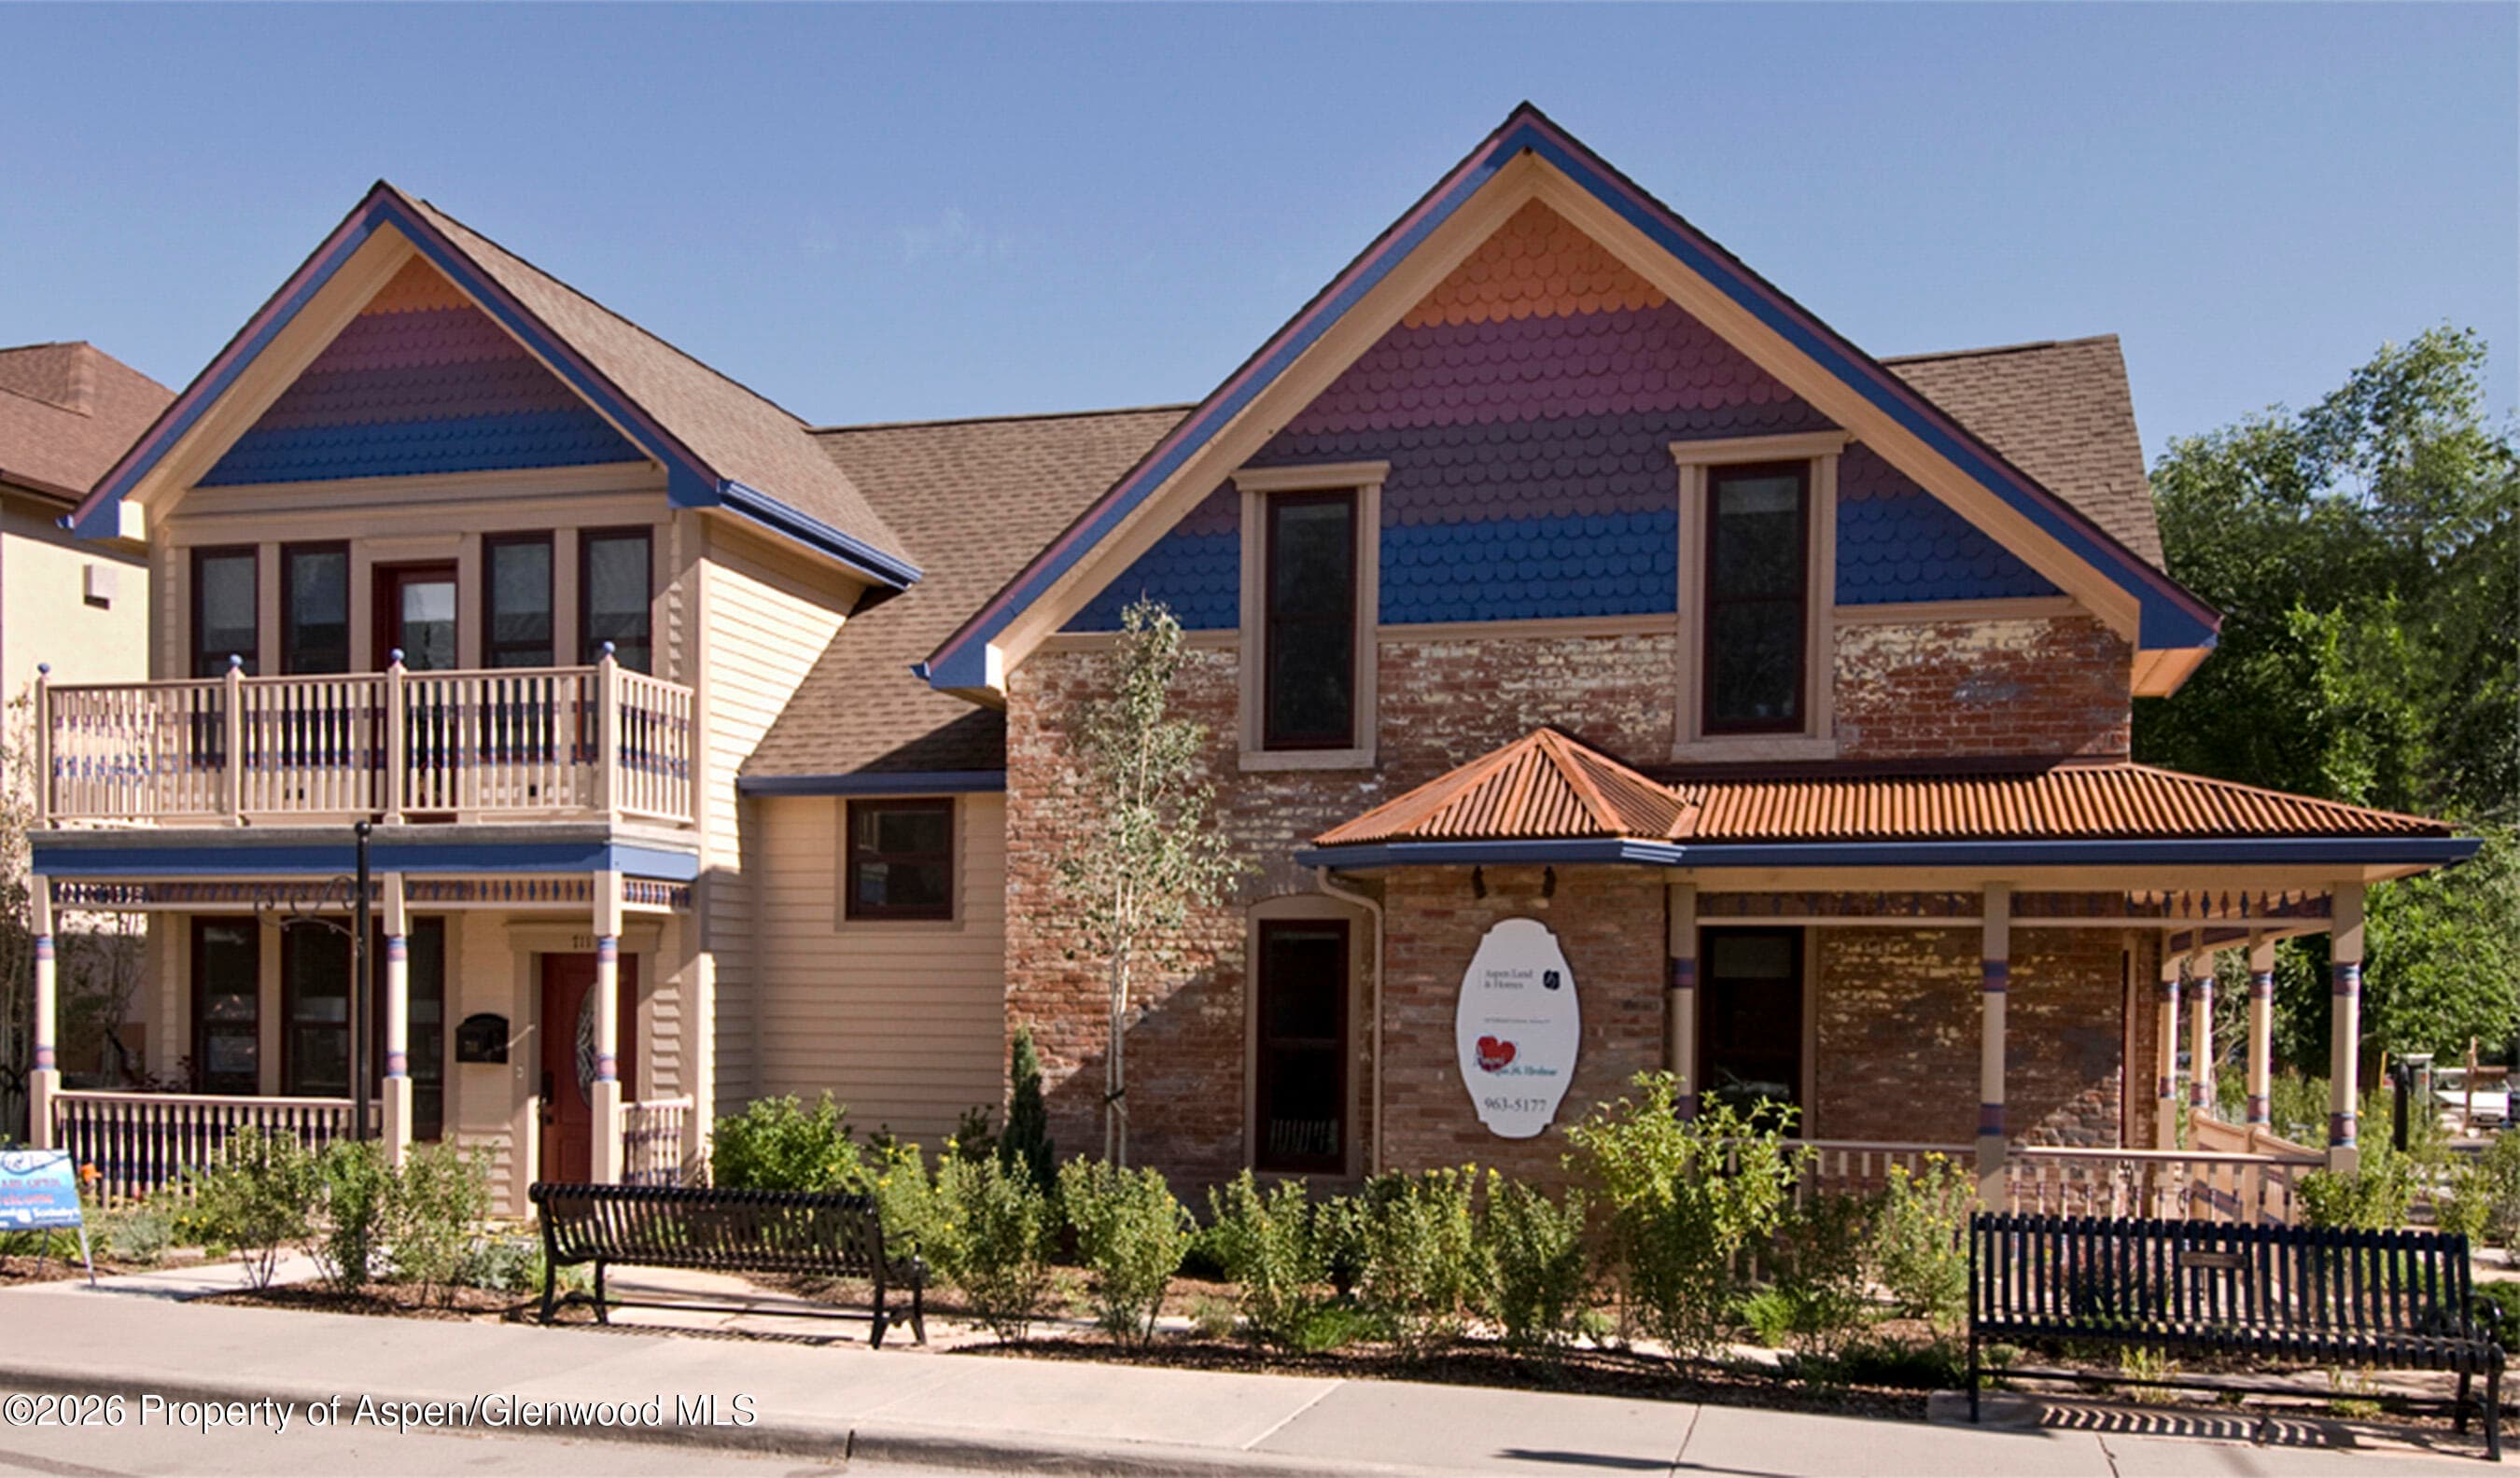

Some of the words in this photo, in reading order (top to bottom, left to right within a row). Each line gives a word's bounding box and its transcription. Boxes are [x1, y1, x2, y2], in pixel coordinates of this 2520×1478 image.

[1485, 969, 1509, 980] Aspen
[1510, 969, 1533, 979] Land
[1484, 1097, 1547, 1112] 963-5177
[0, 1192, 54, 1206] elcome
